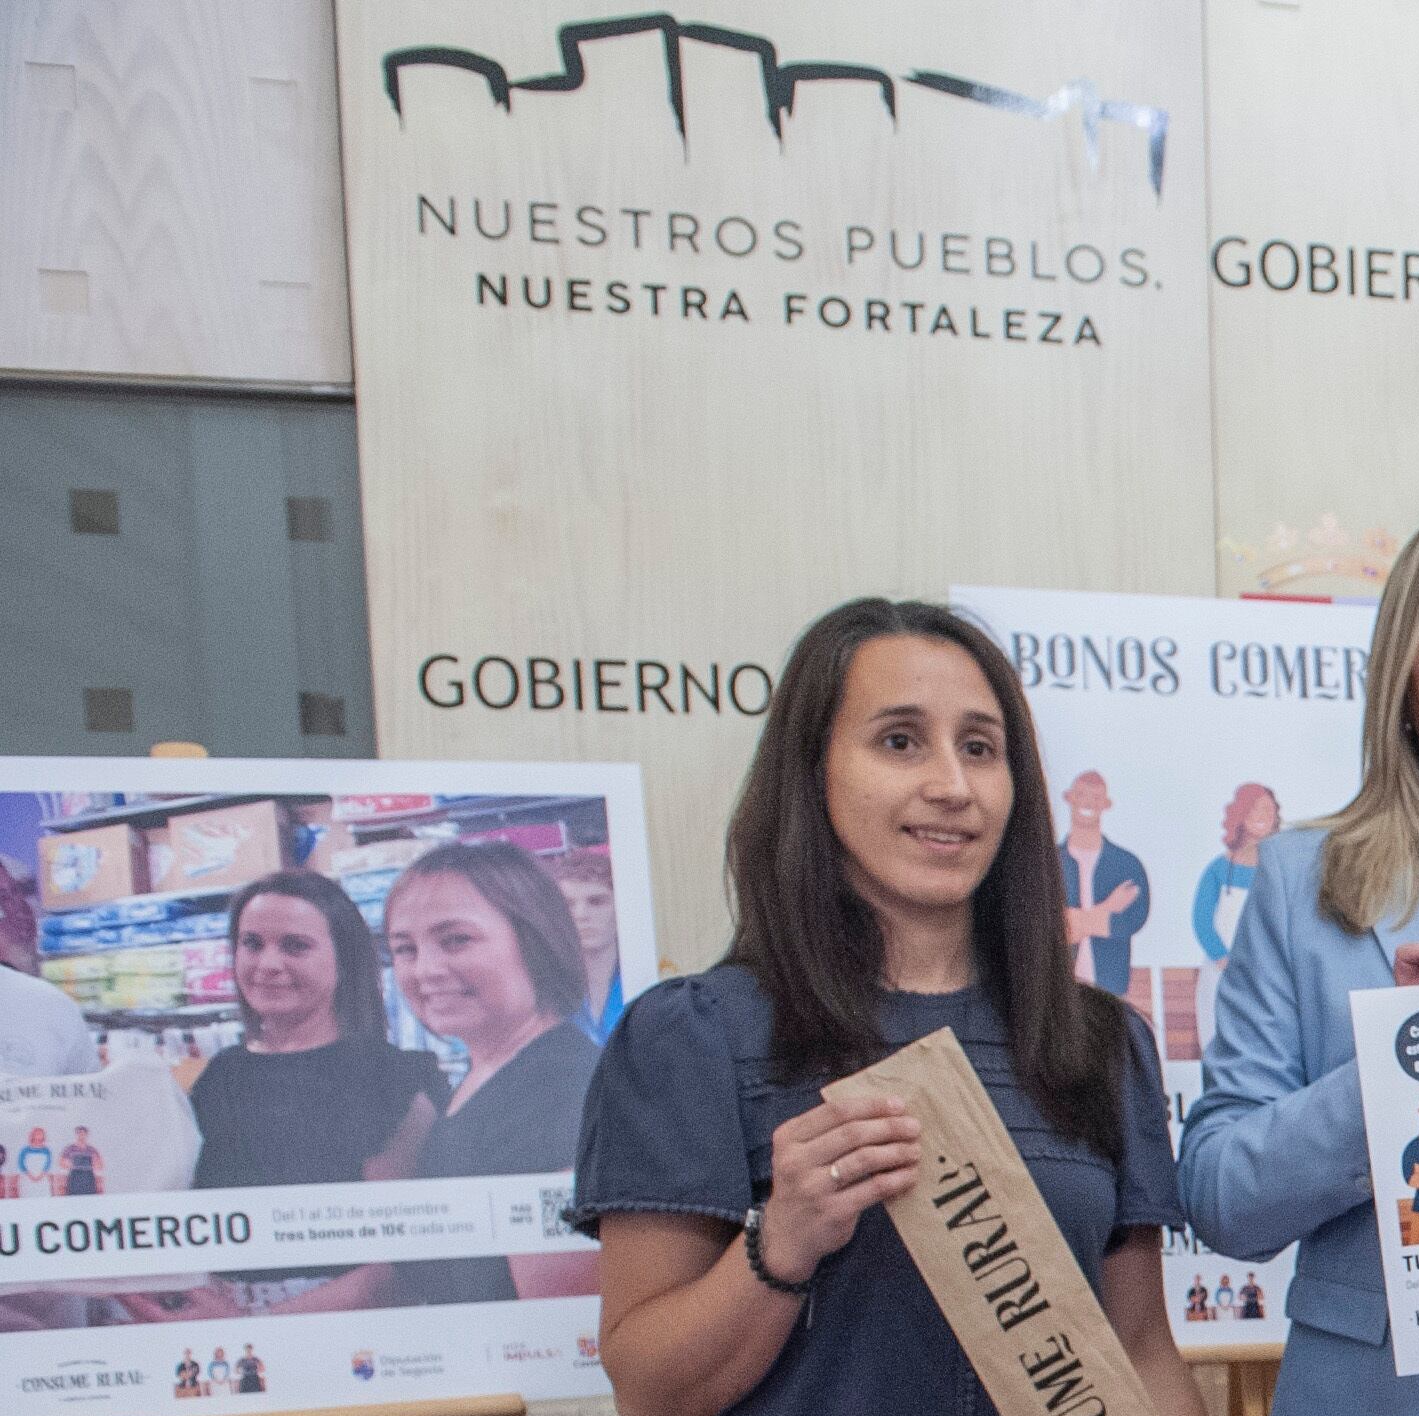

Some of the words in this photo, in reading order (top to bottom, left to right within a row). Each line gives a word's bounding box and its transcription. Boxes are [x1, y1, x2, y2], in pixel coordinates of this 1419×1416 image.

[416, 195, 805, 260] NUESTROS
[847, 226, 1163, 290] PUEBLOS.
[476, 273, 750, 323] NUESTRA
[786, 294, 1104, 347] FORTALEZA
[417, 654, 773, 716] GOBIERNO
[1012, 631, 1180, 696] BONOS
[1210, 640, 1370, 700] COMER
[35, 1211, 251, 1254] COMERCIO
[274, 1230, 304, 1241] tres
[308, 1228, 354, 1241] bonos
[359, 1226, 376, 1238] de
[381, 1223, 405, 1237] 10€
[368, 1203, 449, 1219] septiembre
[931, 1160, 1050, 1333] RURAL
